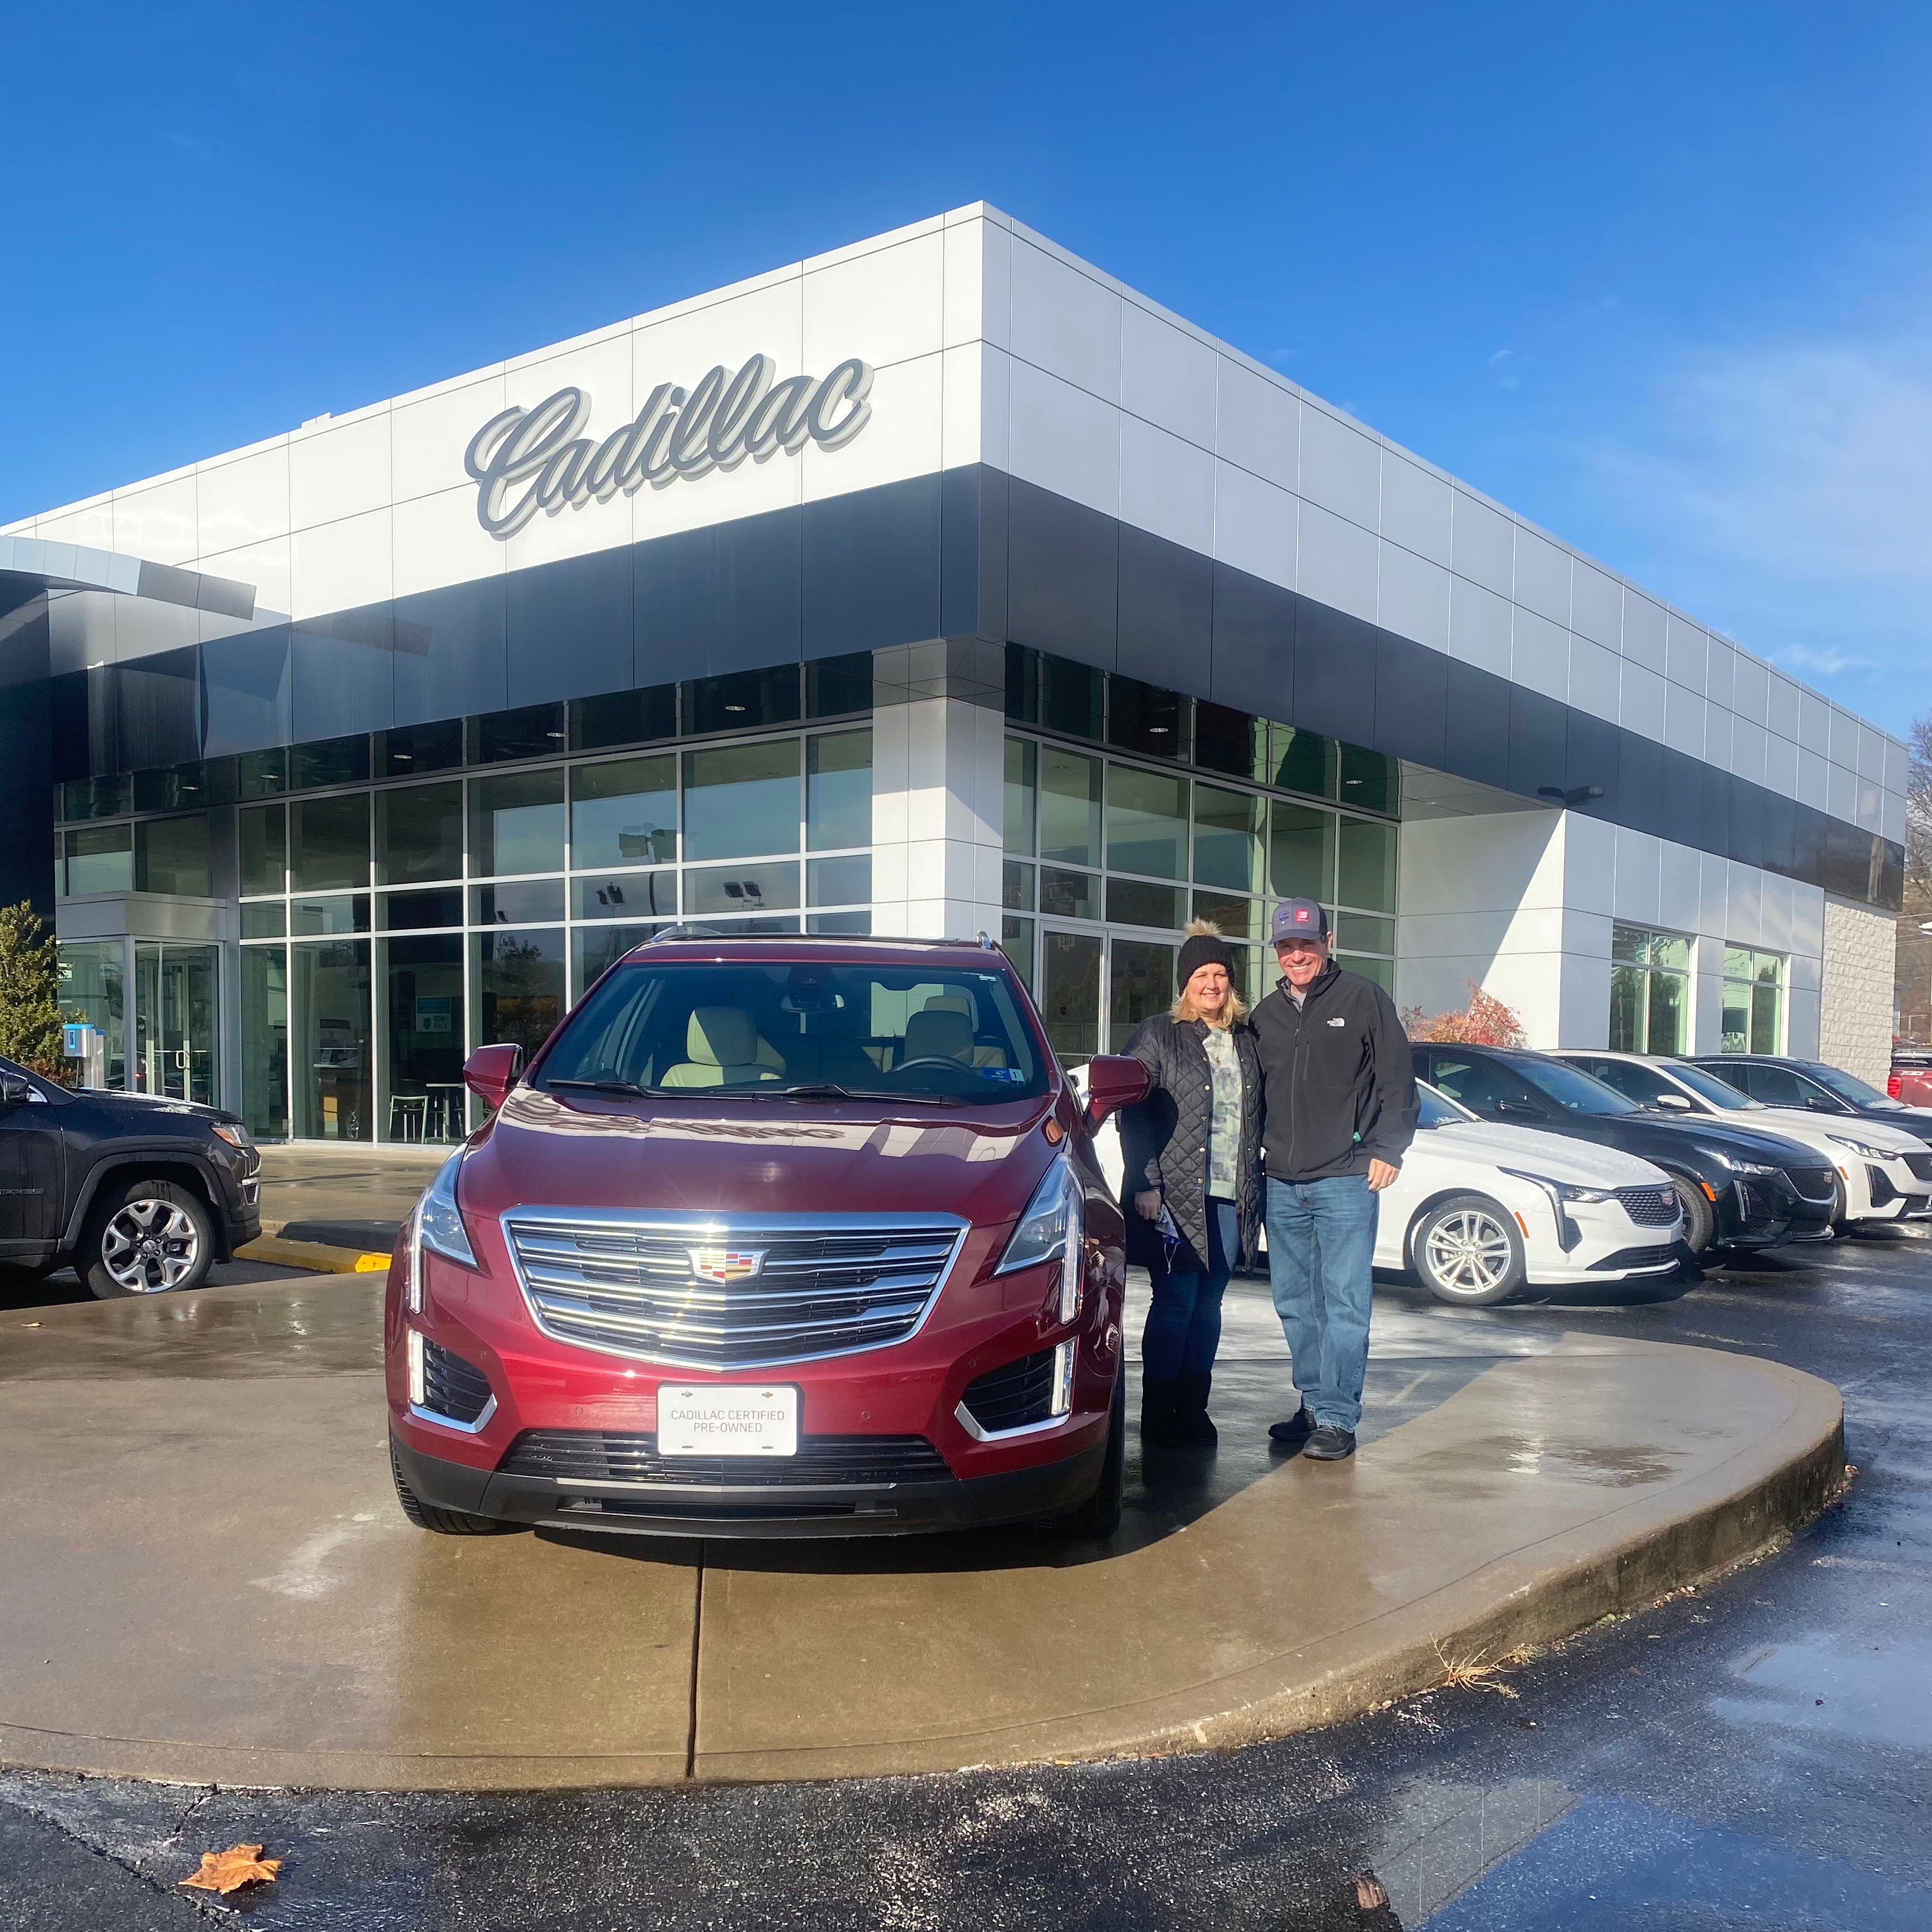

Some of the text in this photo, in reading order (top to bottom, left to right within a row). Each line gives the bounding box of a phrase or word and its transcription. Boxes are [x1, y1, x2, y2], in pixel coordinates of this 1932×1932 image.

[464, 353, 873, 537] Cadillac
[671, 1410, 785, 1420] CADILLAC CERTIFIED
[693, 1422, 763, 1432] PRE-OWNED
